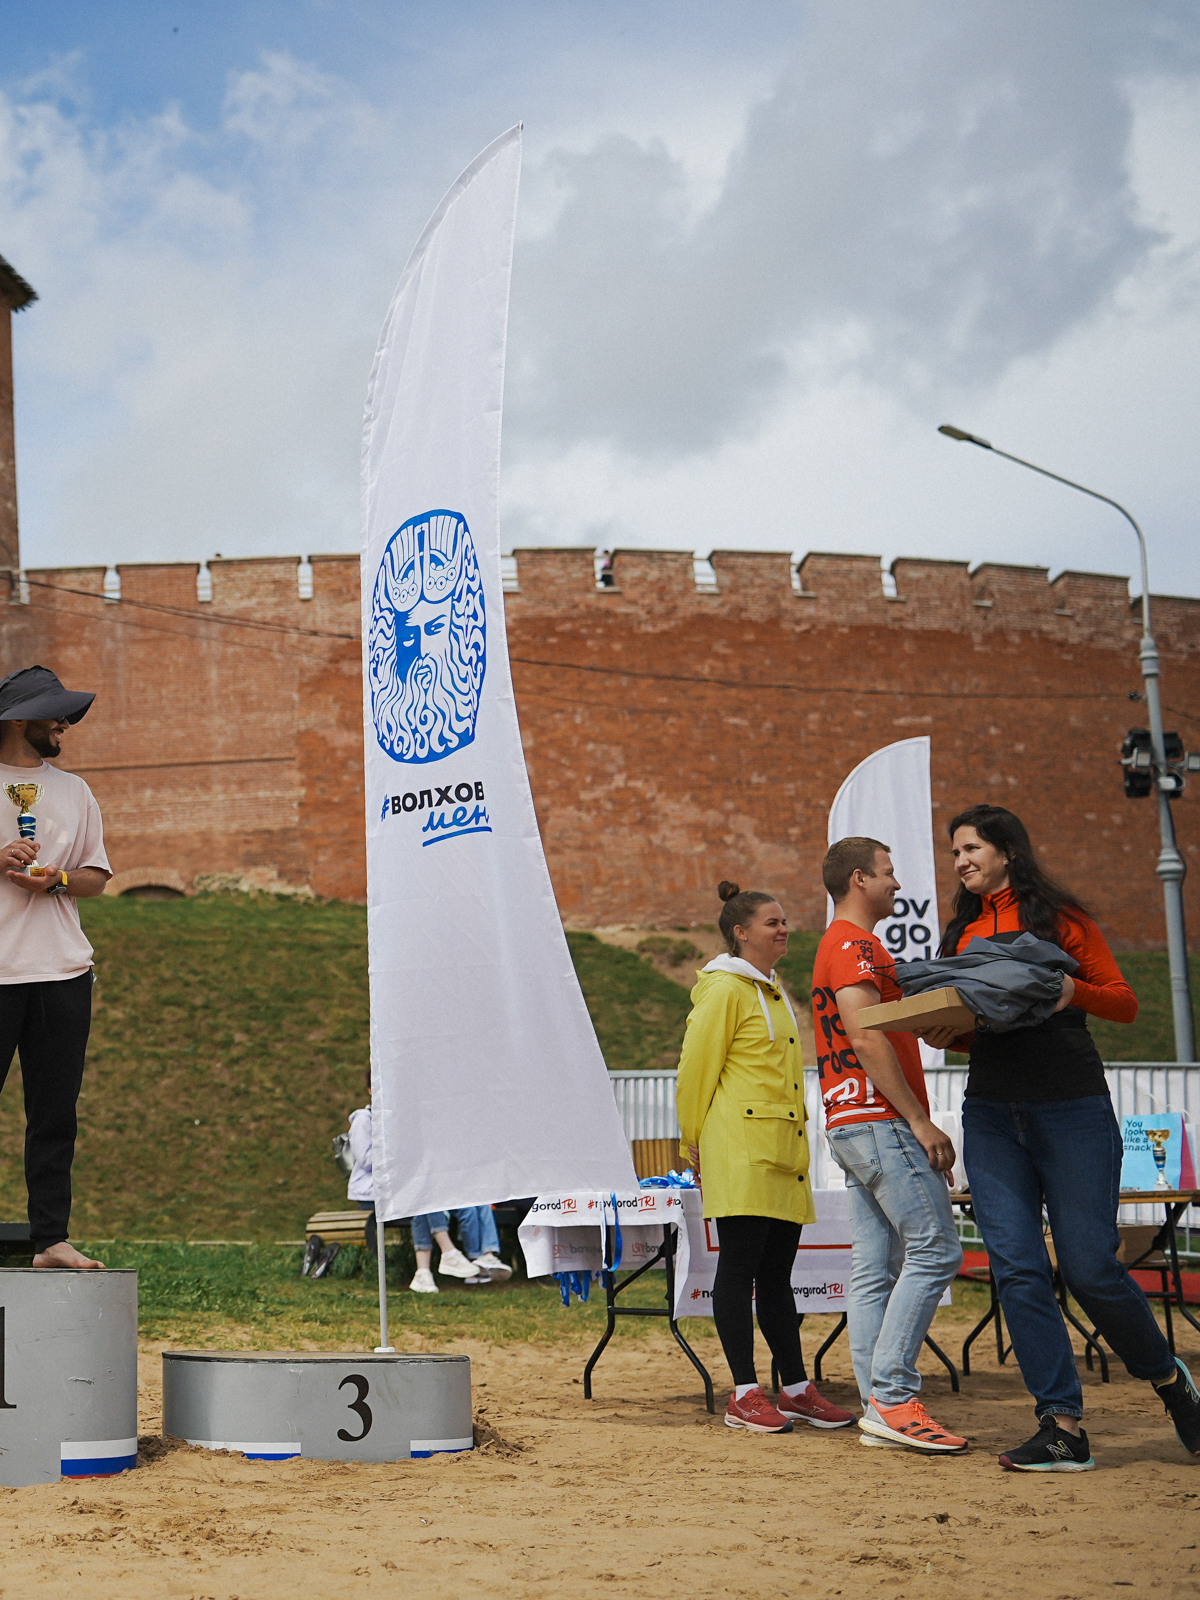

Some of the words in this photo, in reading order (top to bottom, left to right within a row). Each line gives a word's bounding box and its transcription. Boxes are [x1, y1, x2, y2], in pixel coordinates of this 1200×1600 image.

[380, 781, 485, 822] #ВОЛХОВ
[886, 923, 931, 954] go
[1126, 1120, 1143, 1128] You
[337, 1374, 373, 1442] 3
